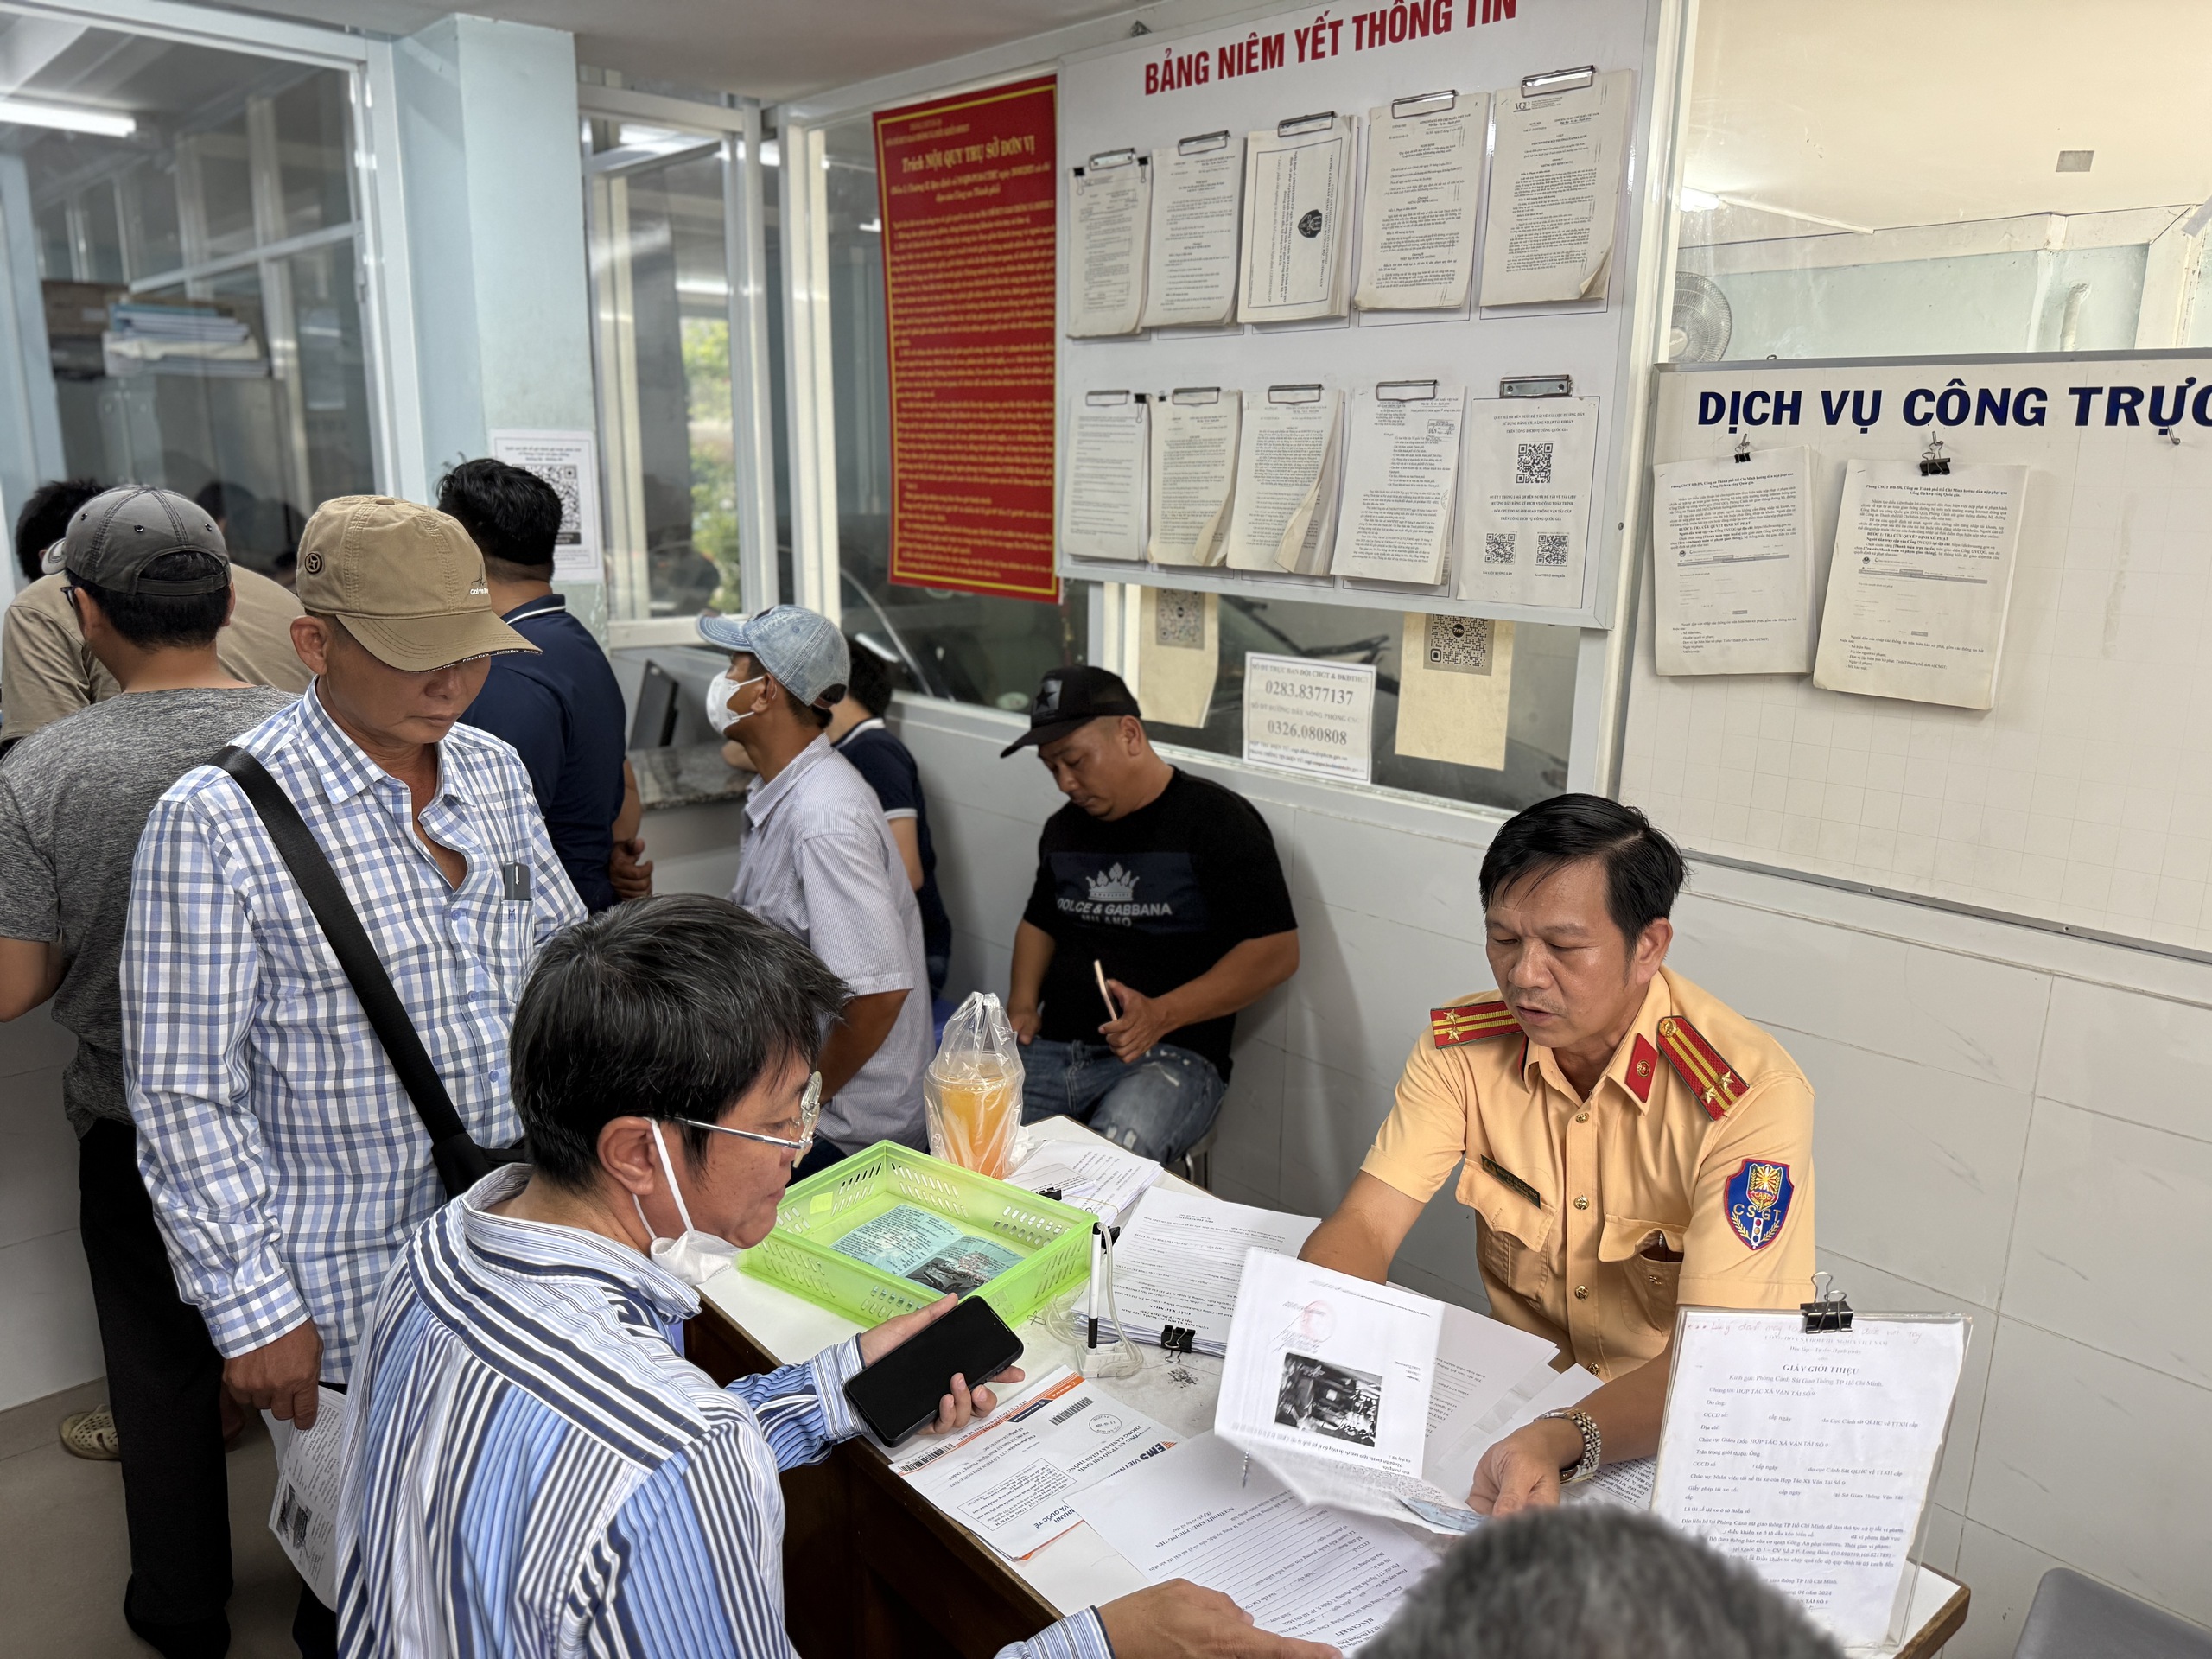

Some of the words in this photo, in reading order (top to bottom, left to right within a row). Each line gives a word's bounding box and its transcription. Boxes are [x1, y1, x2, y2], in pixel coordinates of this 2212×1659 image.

[1145, 48, 1209, 95] BẢNG
[1217, 31, 1285, 80] NIÊM
[1294, 10, 1343, 63] YẾT
[1352, 0, 1452, 51] THÔNG
[1466, 0, 1517, 28] TIN
[944, 147, 963, 168] QUY
[964, 145, 984, 163] TRỤ
[1024, 134, 1035, 156] VỊ
[1698, 389, 1802, 435] DỊCH
[1821, 390, 1882, 434] VỤ
[1903, 378, 2048, 428] CÔNG
[1265, 680, 1354, 706] 0283.8377137
[1268, 719, 1348, 746] 0326.080808
[1093, 904, 1103, 914] &
[1104, 903, 1173, 916] GABBANA
[1733, 1204, 1782, 1222] CSGT
[1831, 1366, 1859, 1376] THIỆU
[1084, 1452, 1099, 1461] GIAO
[1140, 1443, 1166, 1460] EMS
[1066, 1460, 1085, 1473] THÔNG
[1078, 1462, 1094, 1472] MINH
[1059, 1503, 1069, 1512] VÀ
[1042, 1510, 1060, 1522] QUỐC
[1053, 1509, 1075, 1523] NHANH
[1033, 1521, 1044, 1529] TẾ
